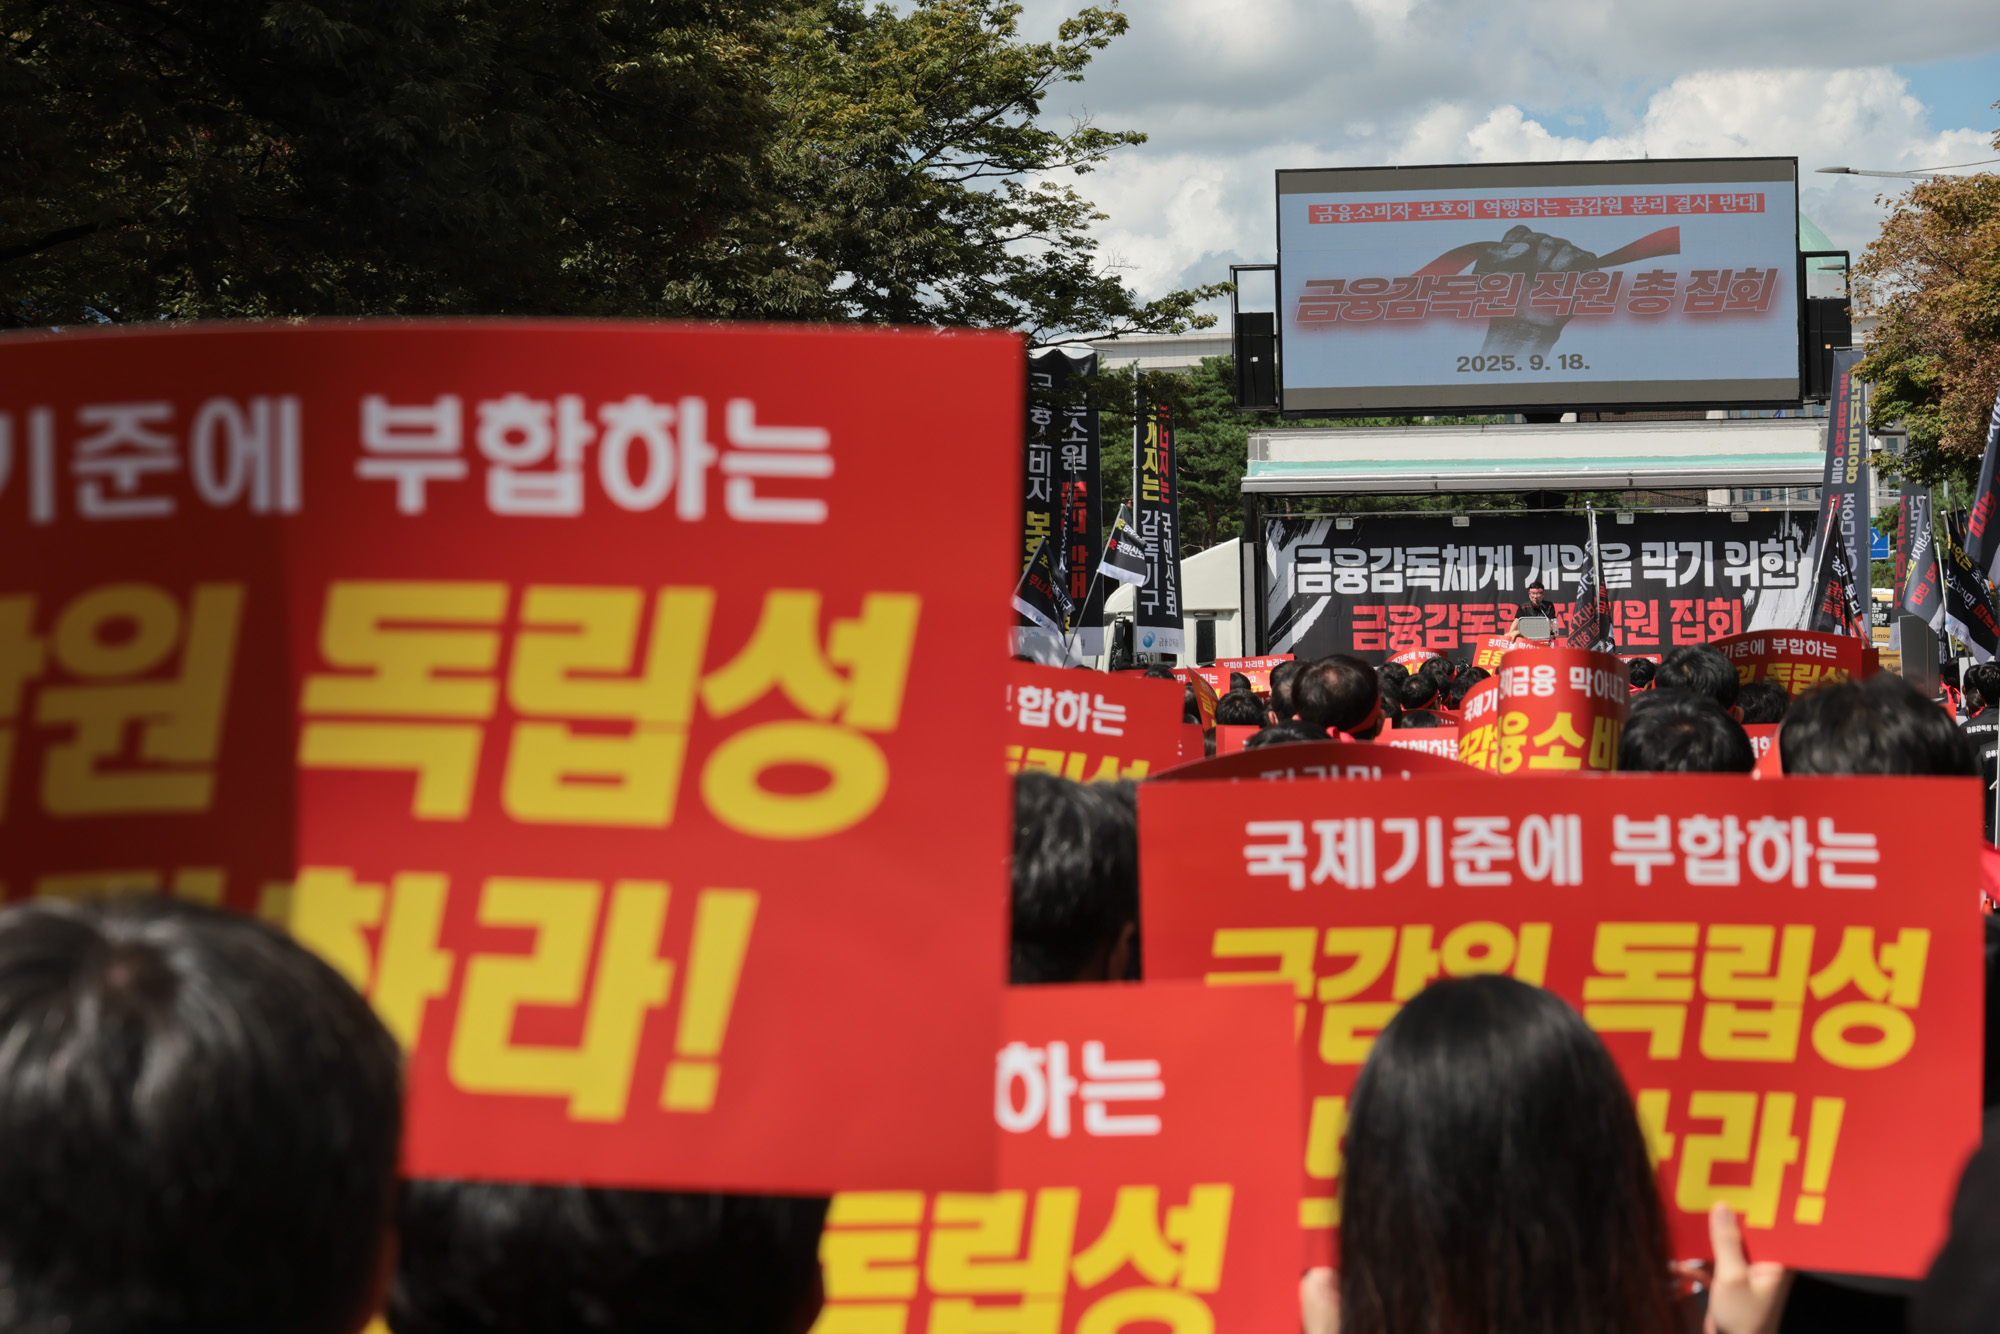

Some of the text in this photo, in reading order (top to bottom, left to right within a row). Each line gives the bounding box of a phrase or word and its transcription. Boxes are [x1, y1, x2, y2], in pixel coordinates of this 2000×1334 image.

[1315, 192, 1758, 222] 금융소비자 보호에 역행하는 금감원 분리 결사 반대
[1295, 268, 1778, 323] 금융감독원 직원 총 집회
[1456, 353, 1591, 373] 2025. 9. 18.
[354, 394, 836, 523] 부합하는
[1029, 573, 1053, 600] 무너지
[1295, 543, 1515, 594] 금융감독체계
[1643, 542, 1713, 588] 막기
[1724, 539, 1800, 588] 위한
[1671, 598, 1742, 645] 집회
[1714, 638, 1837, 660] 기준에 부합하는
[0, 580, 925, 842] 원 독립성
[1006, 685, 1127, 737] 합하는
[1243, 813, 1880, 891] 국제기준에 부합하는
[1582, 920, 1932, 1071] 독립성
